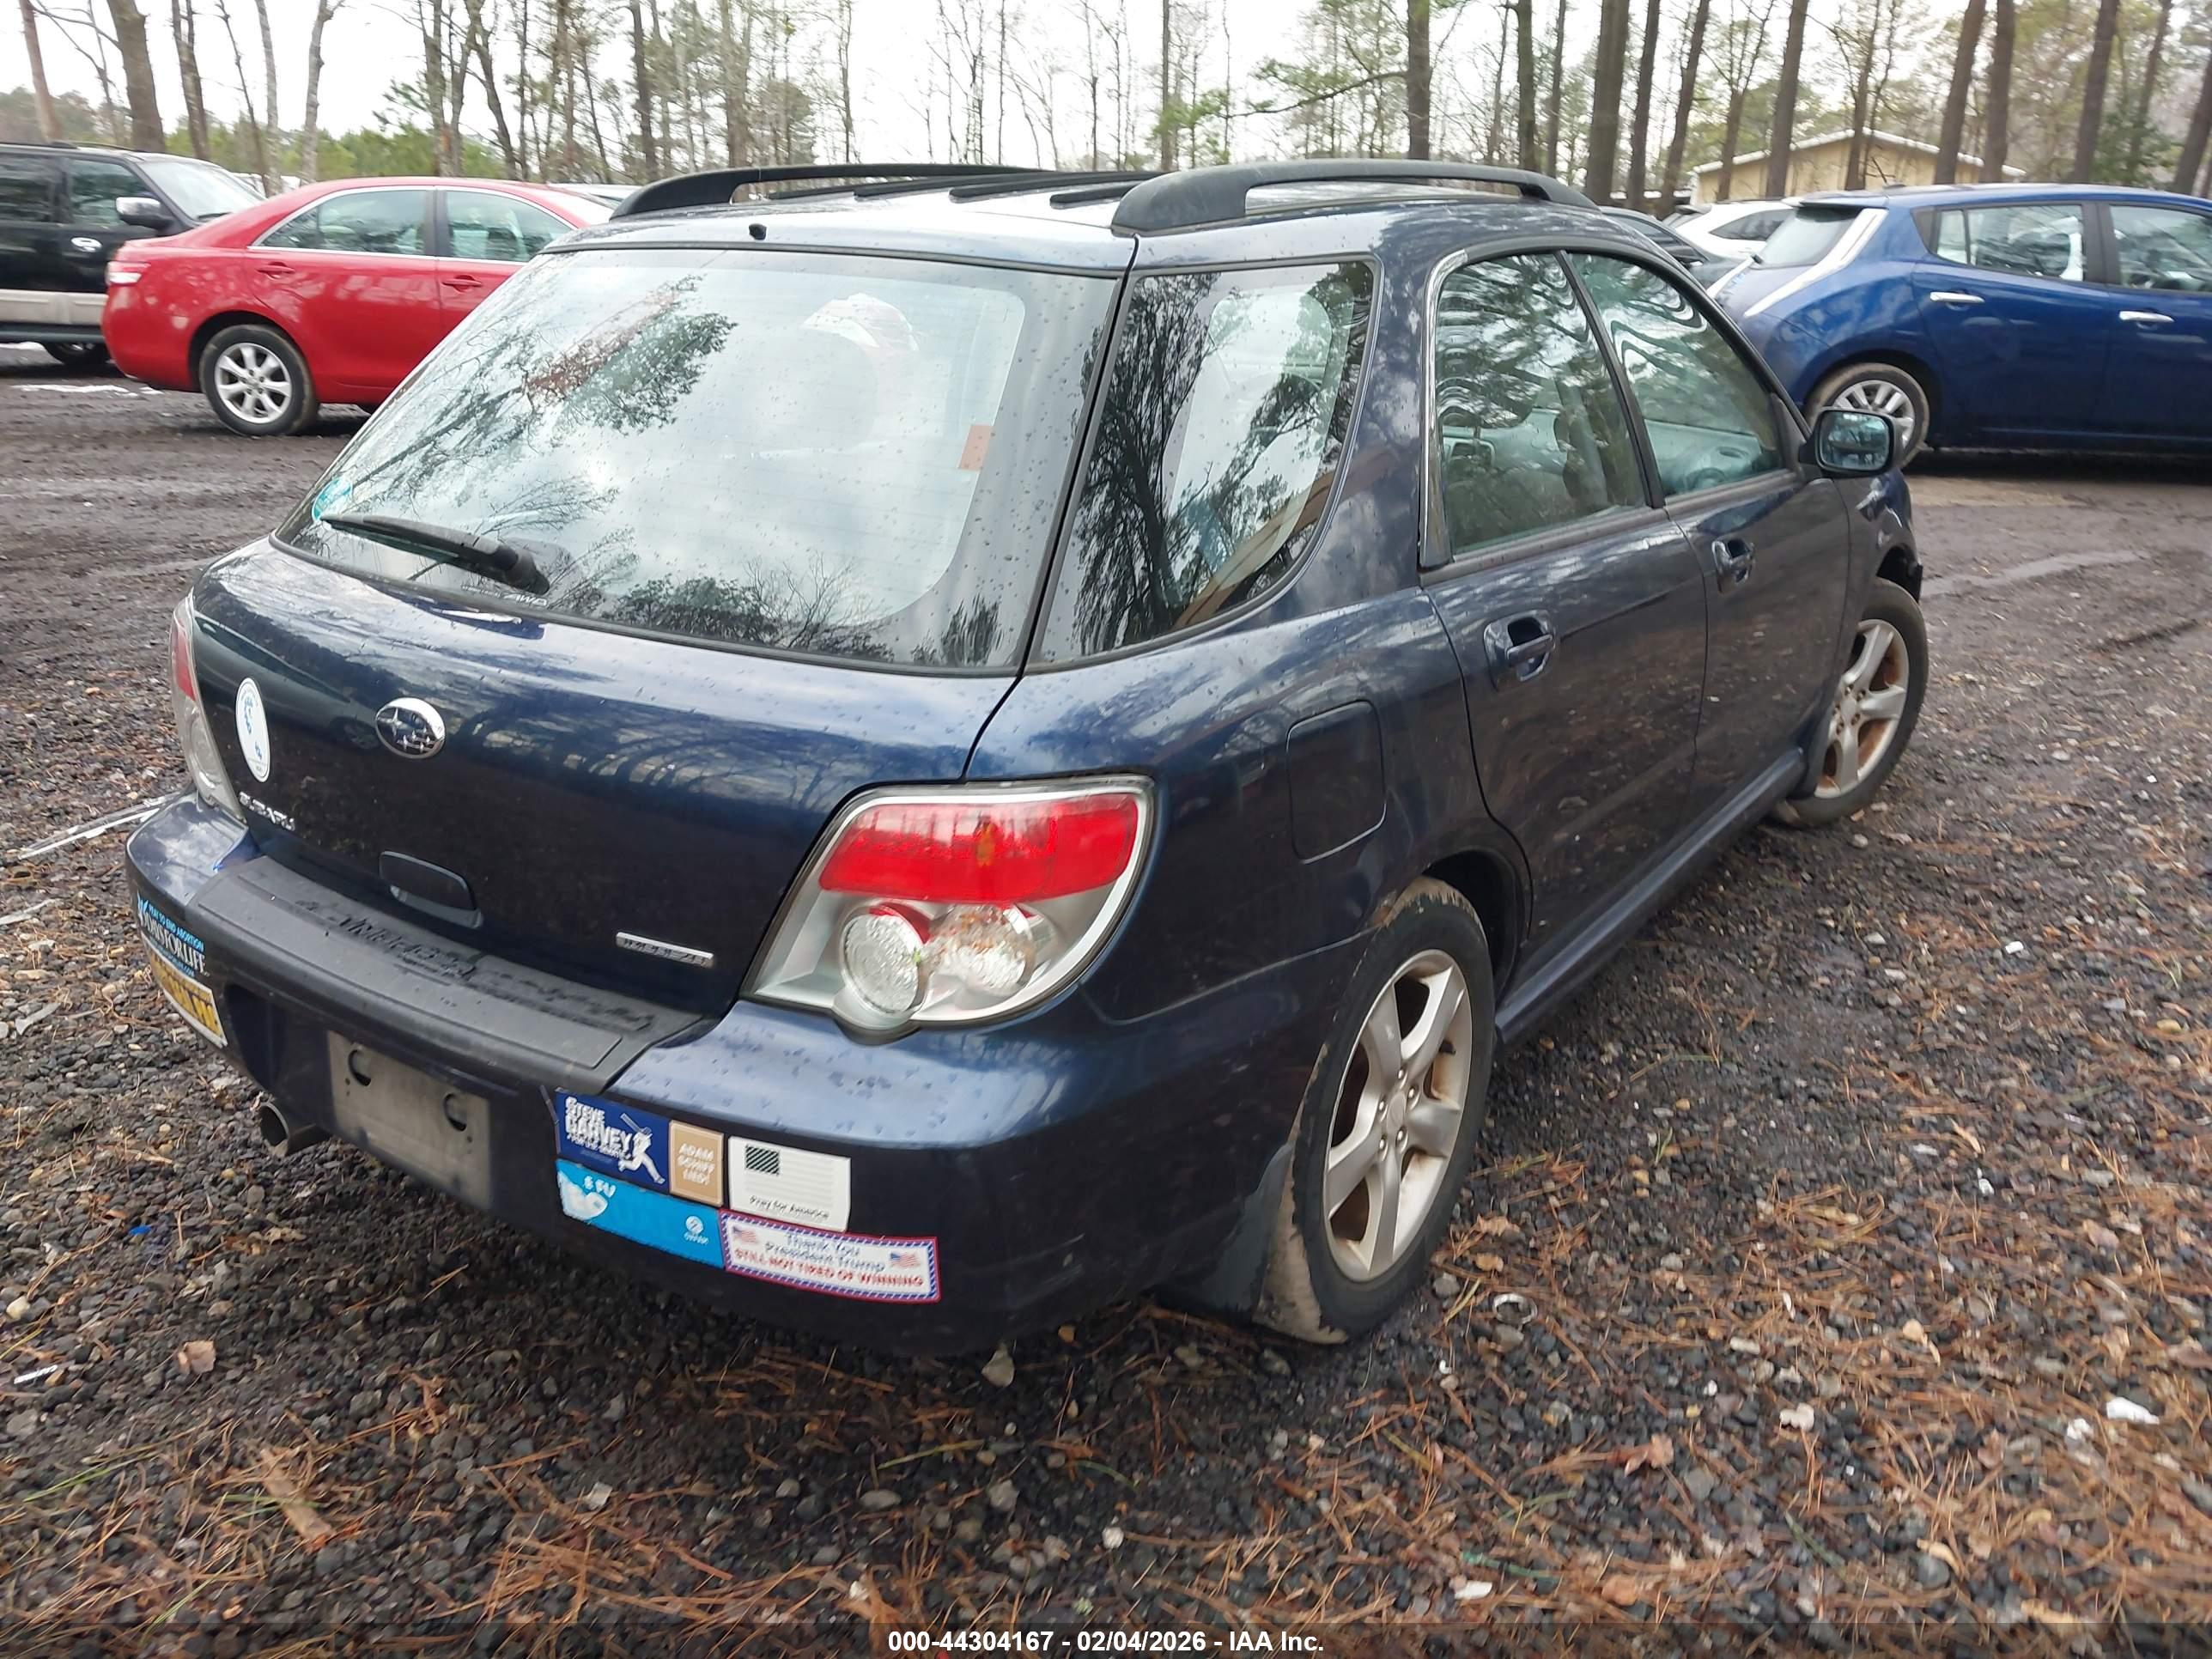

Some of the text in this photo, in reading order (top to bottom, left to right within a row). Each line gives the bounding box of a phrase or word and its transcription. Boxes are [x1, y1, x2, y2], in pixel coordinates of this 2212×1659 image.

[503, 592, 549, 607] AWD
[565, 1097, 605, 1121] STEVE
[565, 1114, 633, 1151] GARVEY
[789, 1203, 830, 1219] America
[734, 1248, 924, 1288] STILL NOT TIRED OF WINNING
[838, 1255, 886, 1273] Trump
